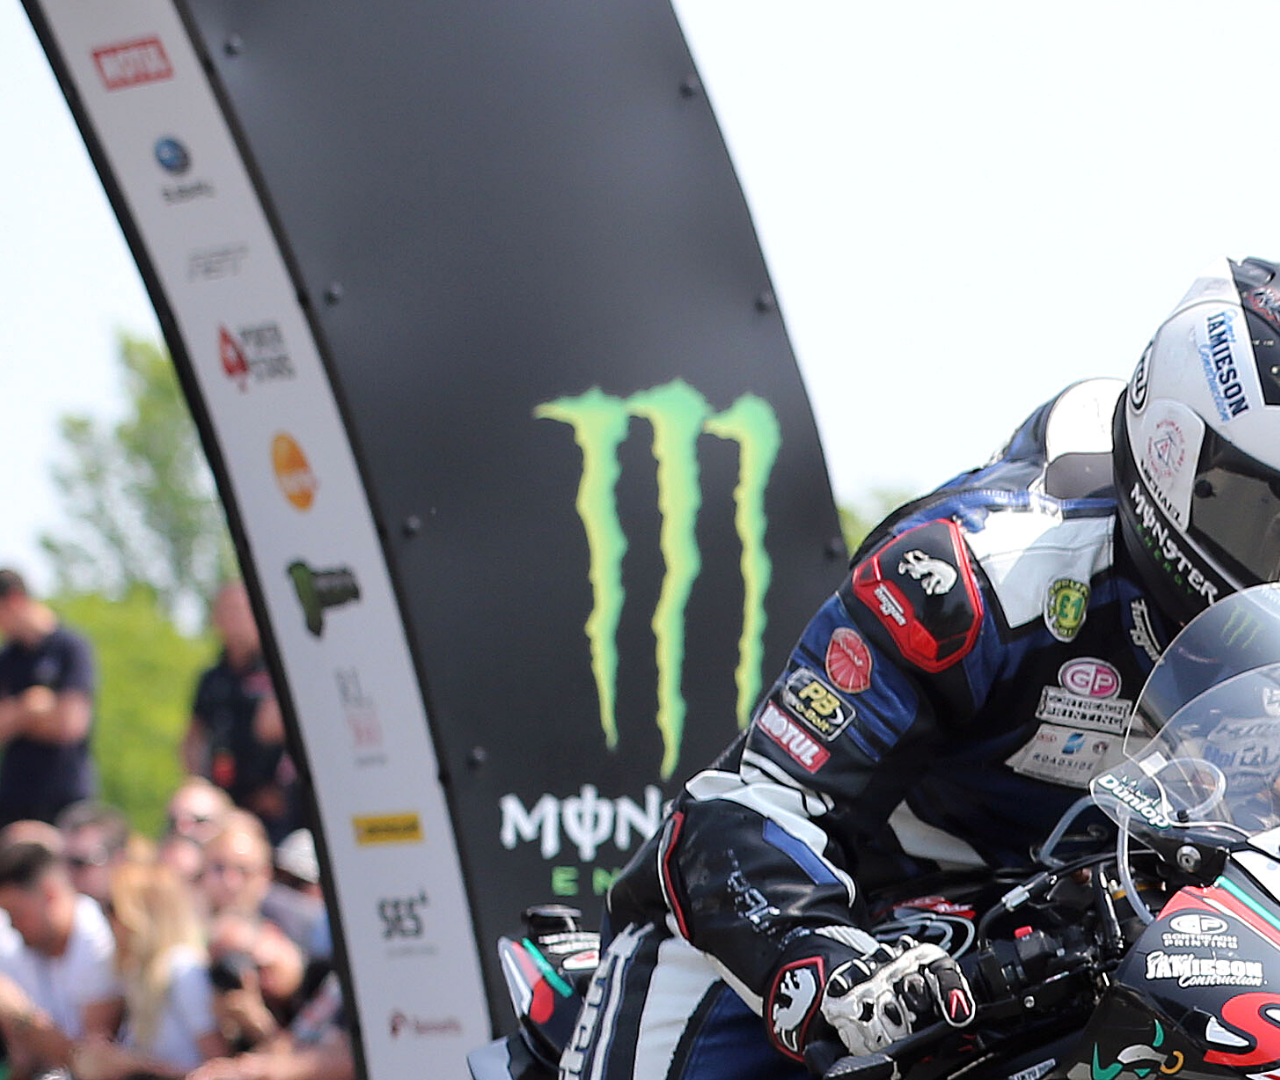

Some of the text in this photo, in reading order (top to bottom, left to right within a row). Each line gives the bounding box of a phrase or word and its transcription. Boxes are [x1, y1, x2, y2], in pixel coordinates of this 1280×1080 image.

[1130, 482, 1219, 605] MONSTER
[1068, 668, 1117, 694] GP
[759, 703, 821, 767] MOTUL
[1097, 773, 1172, 829] Dunlop
[1163, 940, 1239, 950] PRINTING
[1146, 957, 1263, 980] JAMIESON
